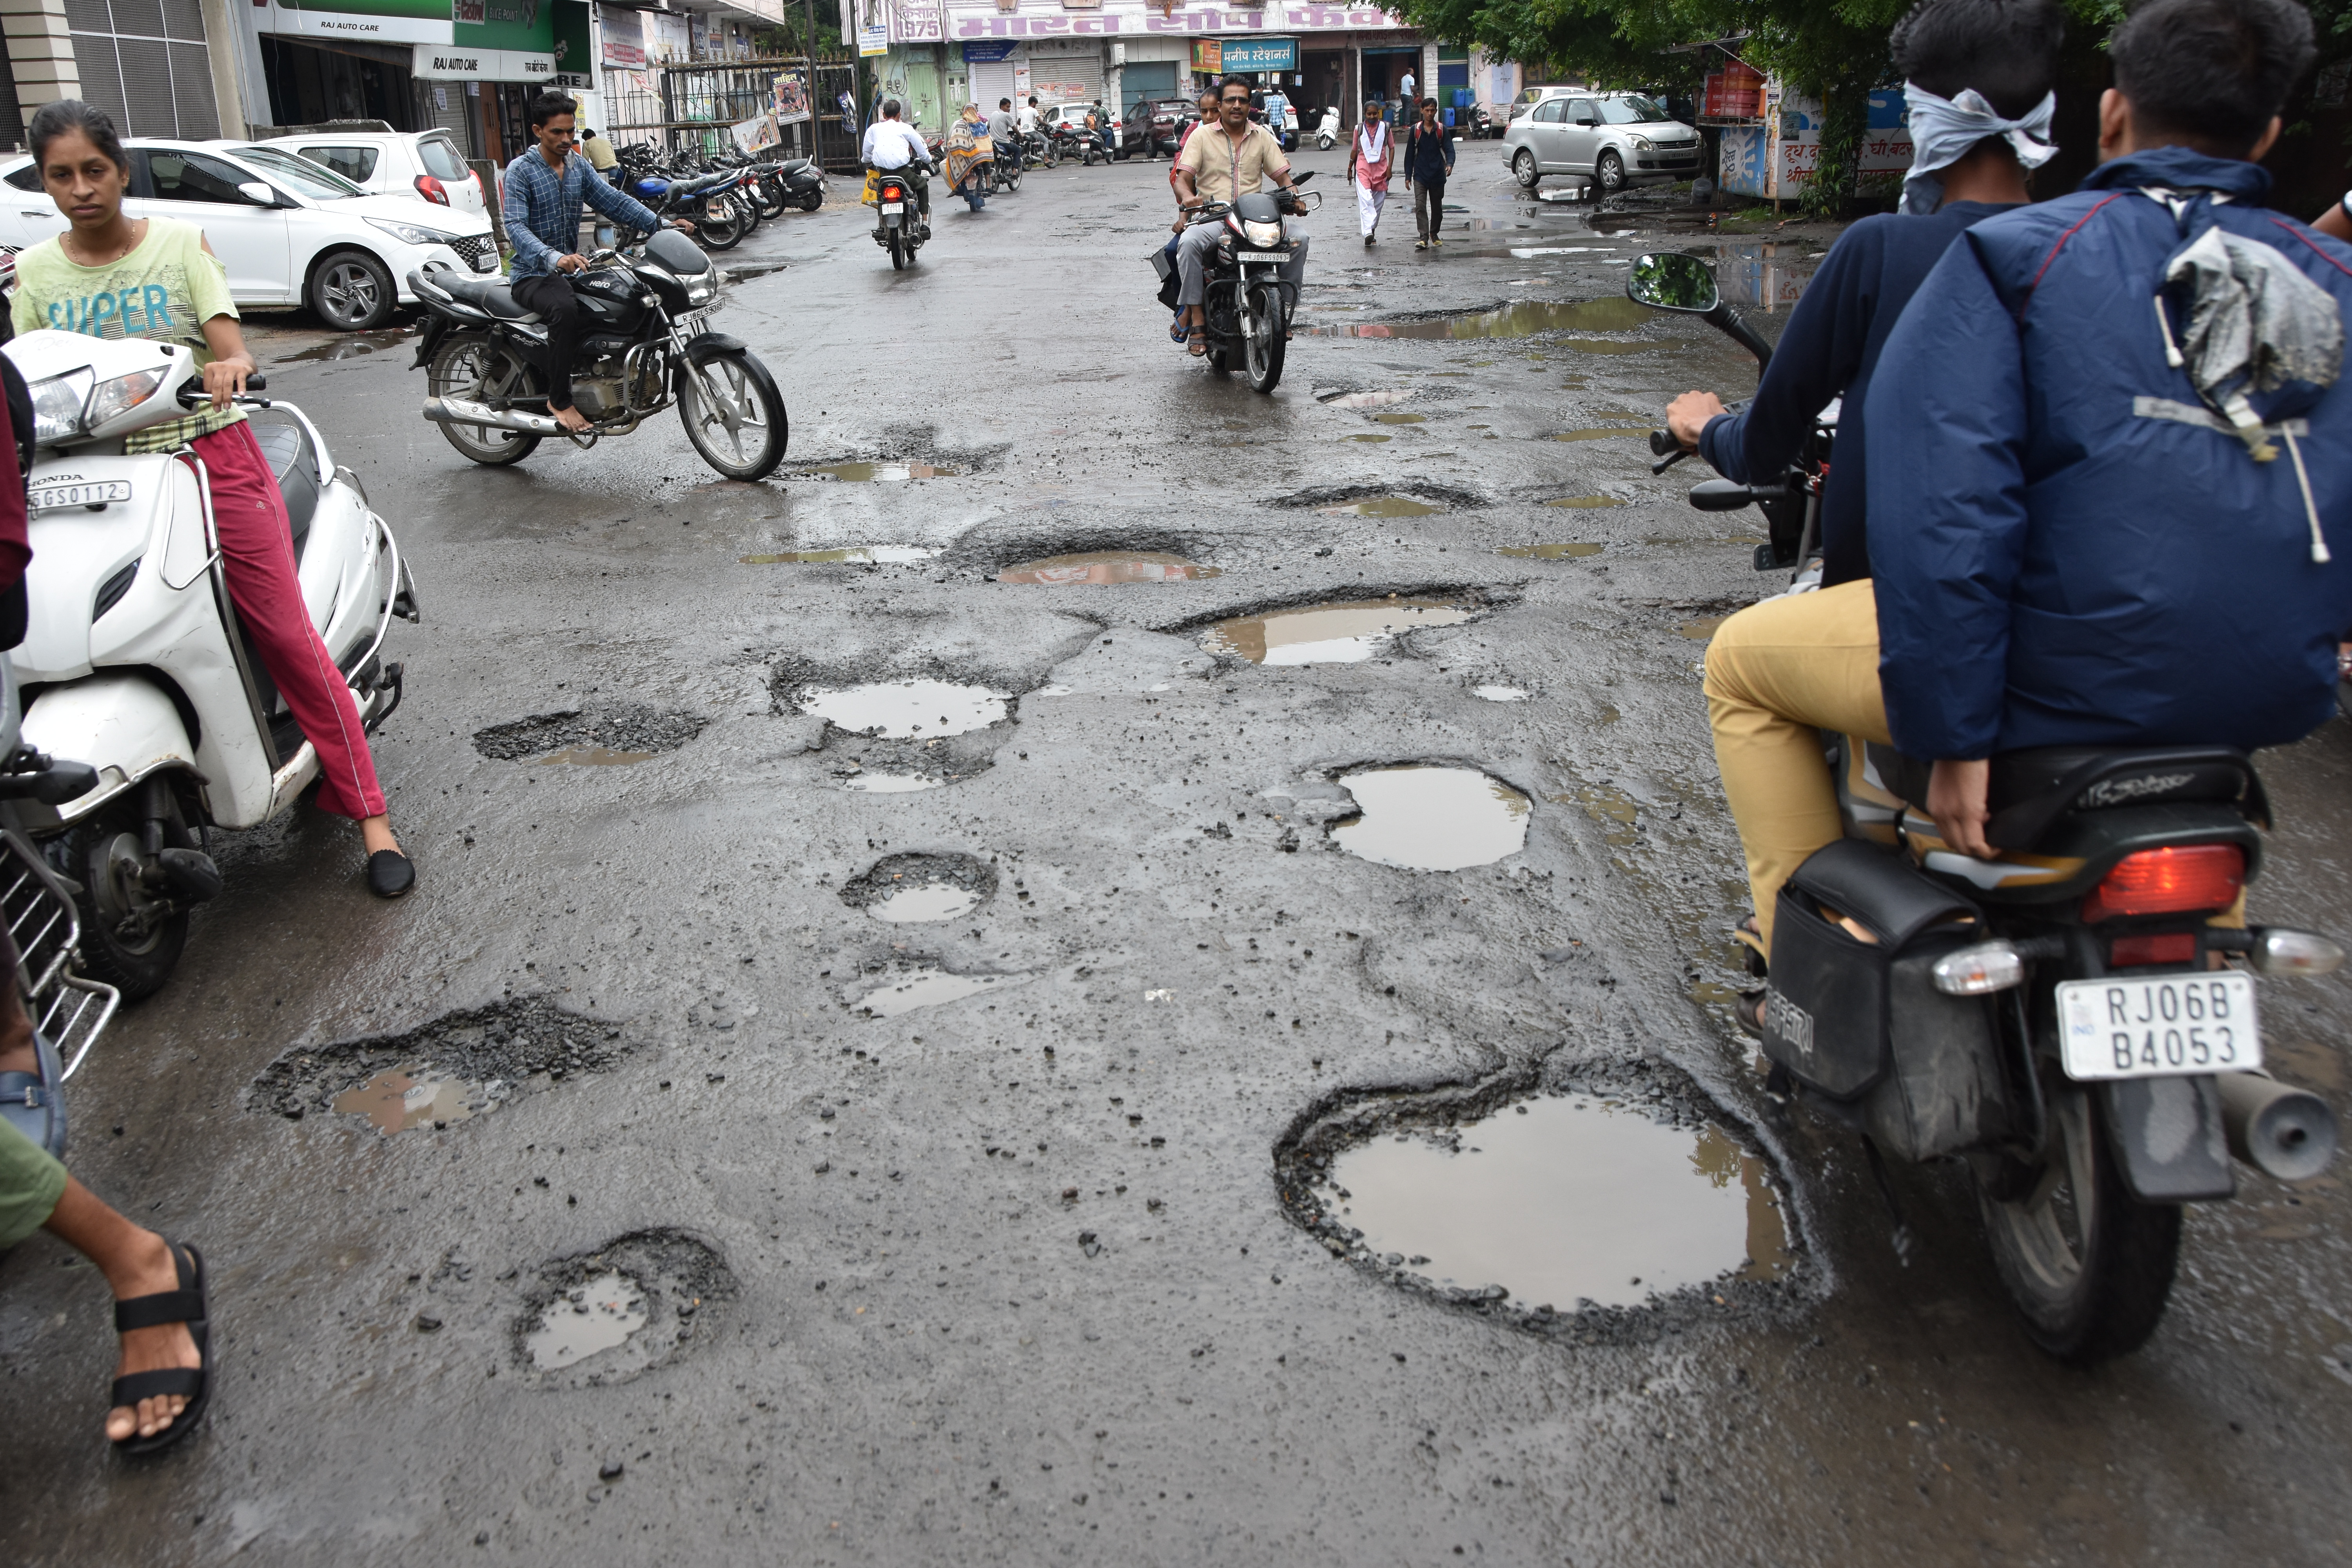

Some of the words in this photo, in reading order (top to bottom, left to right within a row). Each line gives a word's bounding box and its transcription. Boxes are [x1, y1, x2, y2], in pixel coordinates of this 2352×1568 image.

[489, 7, 501, 20] BIKE
[503, 9, 518, 22] POINT
[898, 20, 938, 37] 1975
[957, 15, 1123, 36] भारत
[1224, 47, 1249, 62] मनीष
[1252, 45, 1291, 61] स्टेशनर्स
[433, 57, 448, 70] RAJ
[448, 58, 463, 71] AUTO
[464, 59, 478, 71] CARE
[773, 73, 797, 84] साहिल
[49, 284, 174, 338] SUPER
[28, 474, 85, 488] HONDA
[2107, 982, 2229, 1025] RJ06B
[2112, 1026, 2236, 1069] B4053
